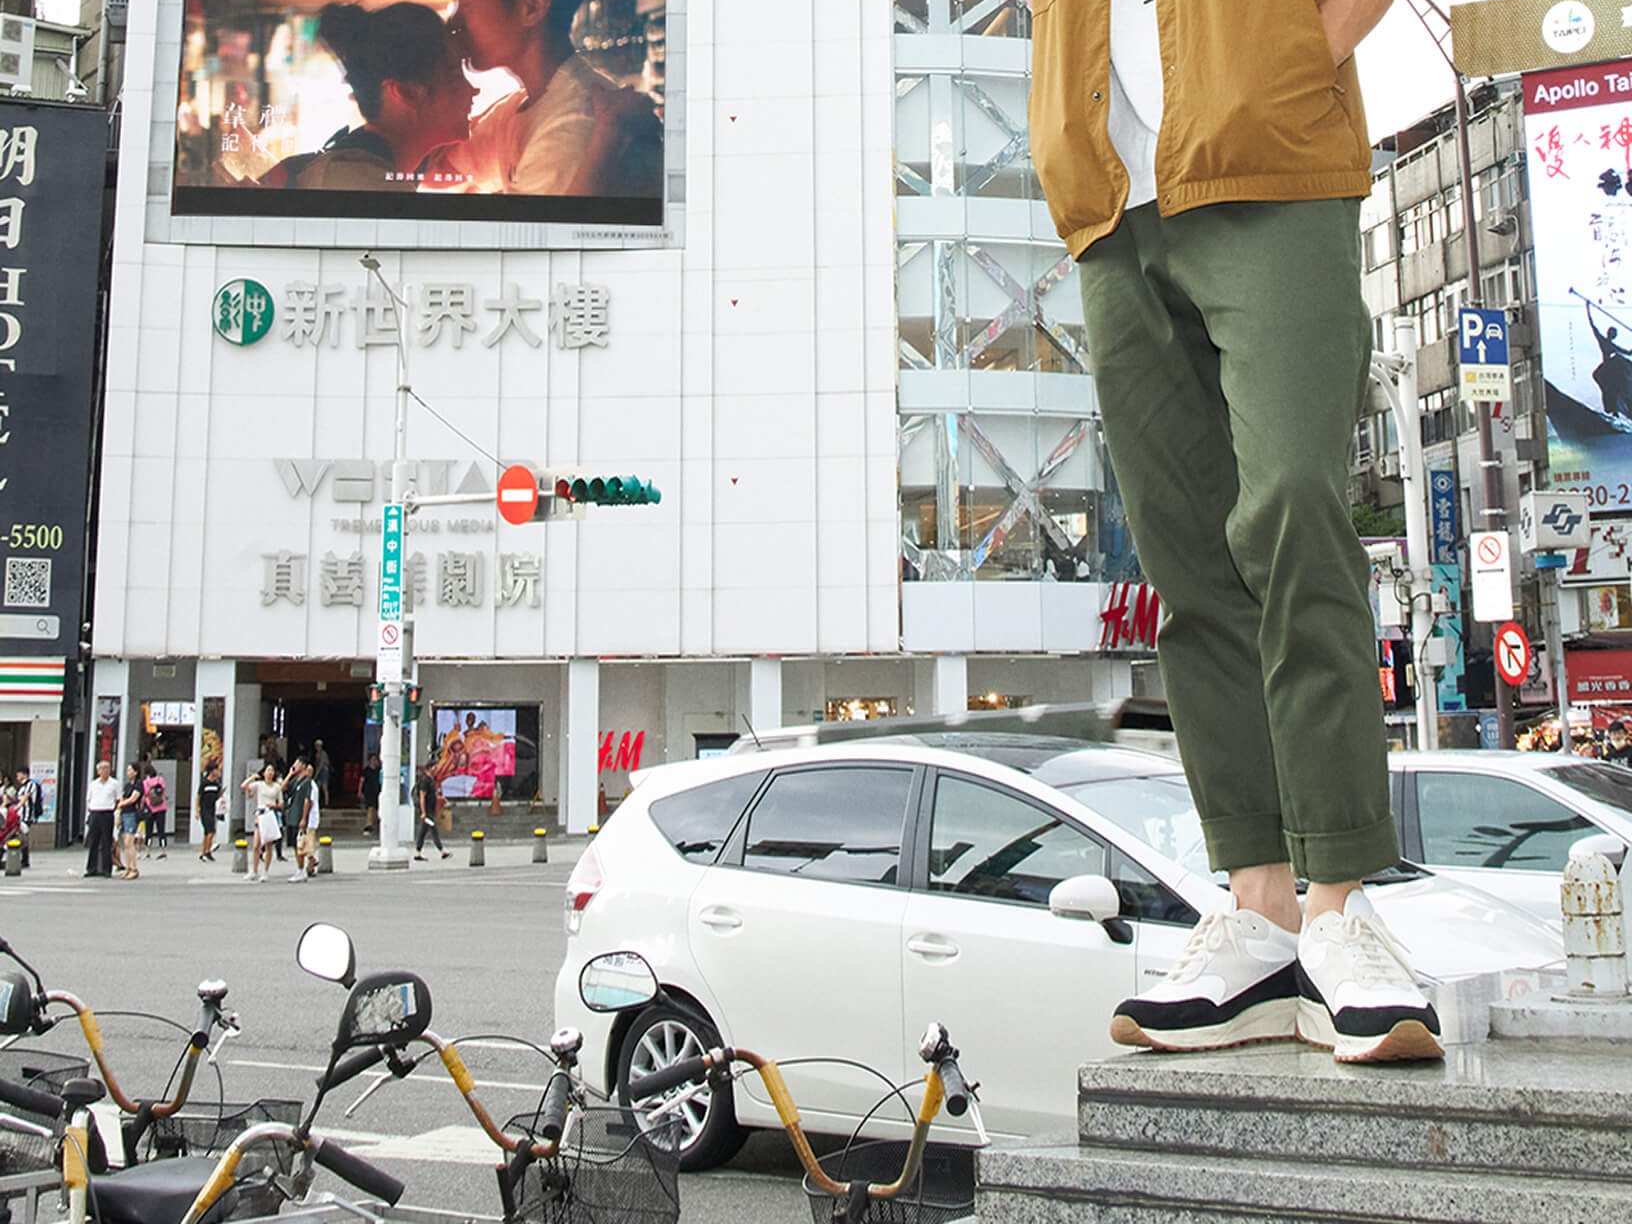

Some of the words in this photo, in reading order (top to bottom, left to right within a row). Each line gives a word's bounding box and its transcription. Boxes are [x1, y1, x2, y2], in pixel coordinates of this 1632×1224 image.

[1534, 79, 1599, 105] Apollo
[281, 281, 610, 350] 新世界大樓
[1462, 313, 1484, 349] P
[1, 524, 63, 550] -5500
[331, 519, 441, 534] TREMEOUS
[447, 519, 496, 534] MEDIA
[1100, 580, 1160, 649] H&M
[598, 730, 645, 774] H&M
